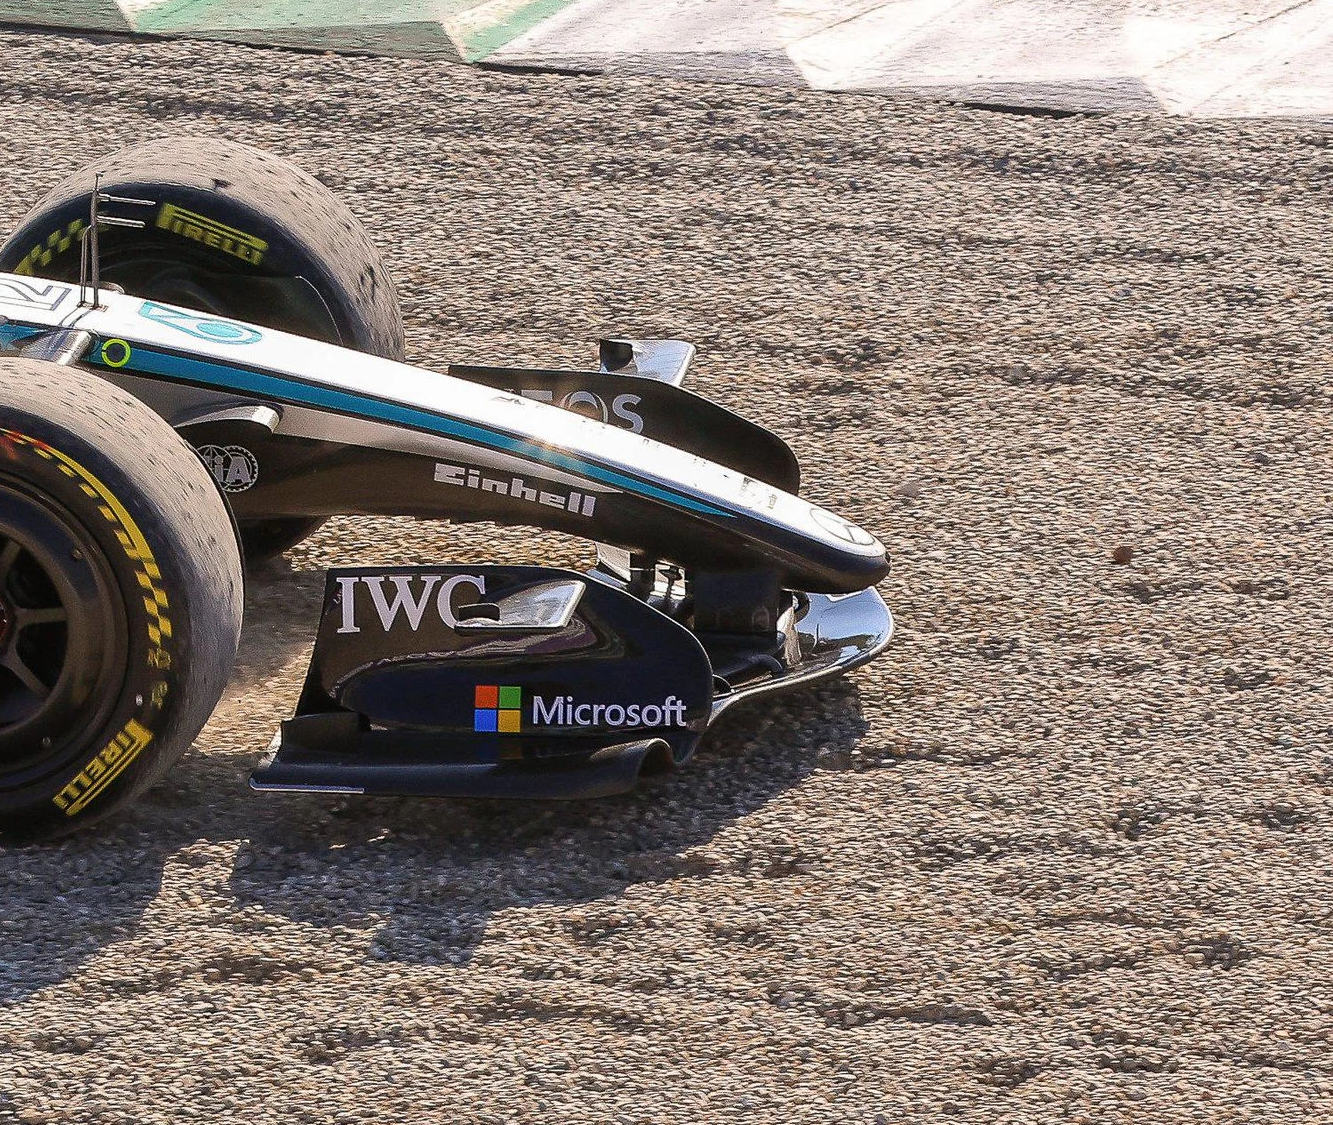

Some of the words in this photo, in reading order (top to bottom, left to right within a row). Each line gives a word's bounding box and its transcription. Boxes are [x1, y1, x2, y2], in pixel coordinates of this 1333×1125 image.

[433, 462, 597, 518] Einhell
[336, 574, 486, 634] IWC
[532, 696, 688, 727] Microsoft
[52, 717, 154, 817] PIRELLI
